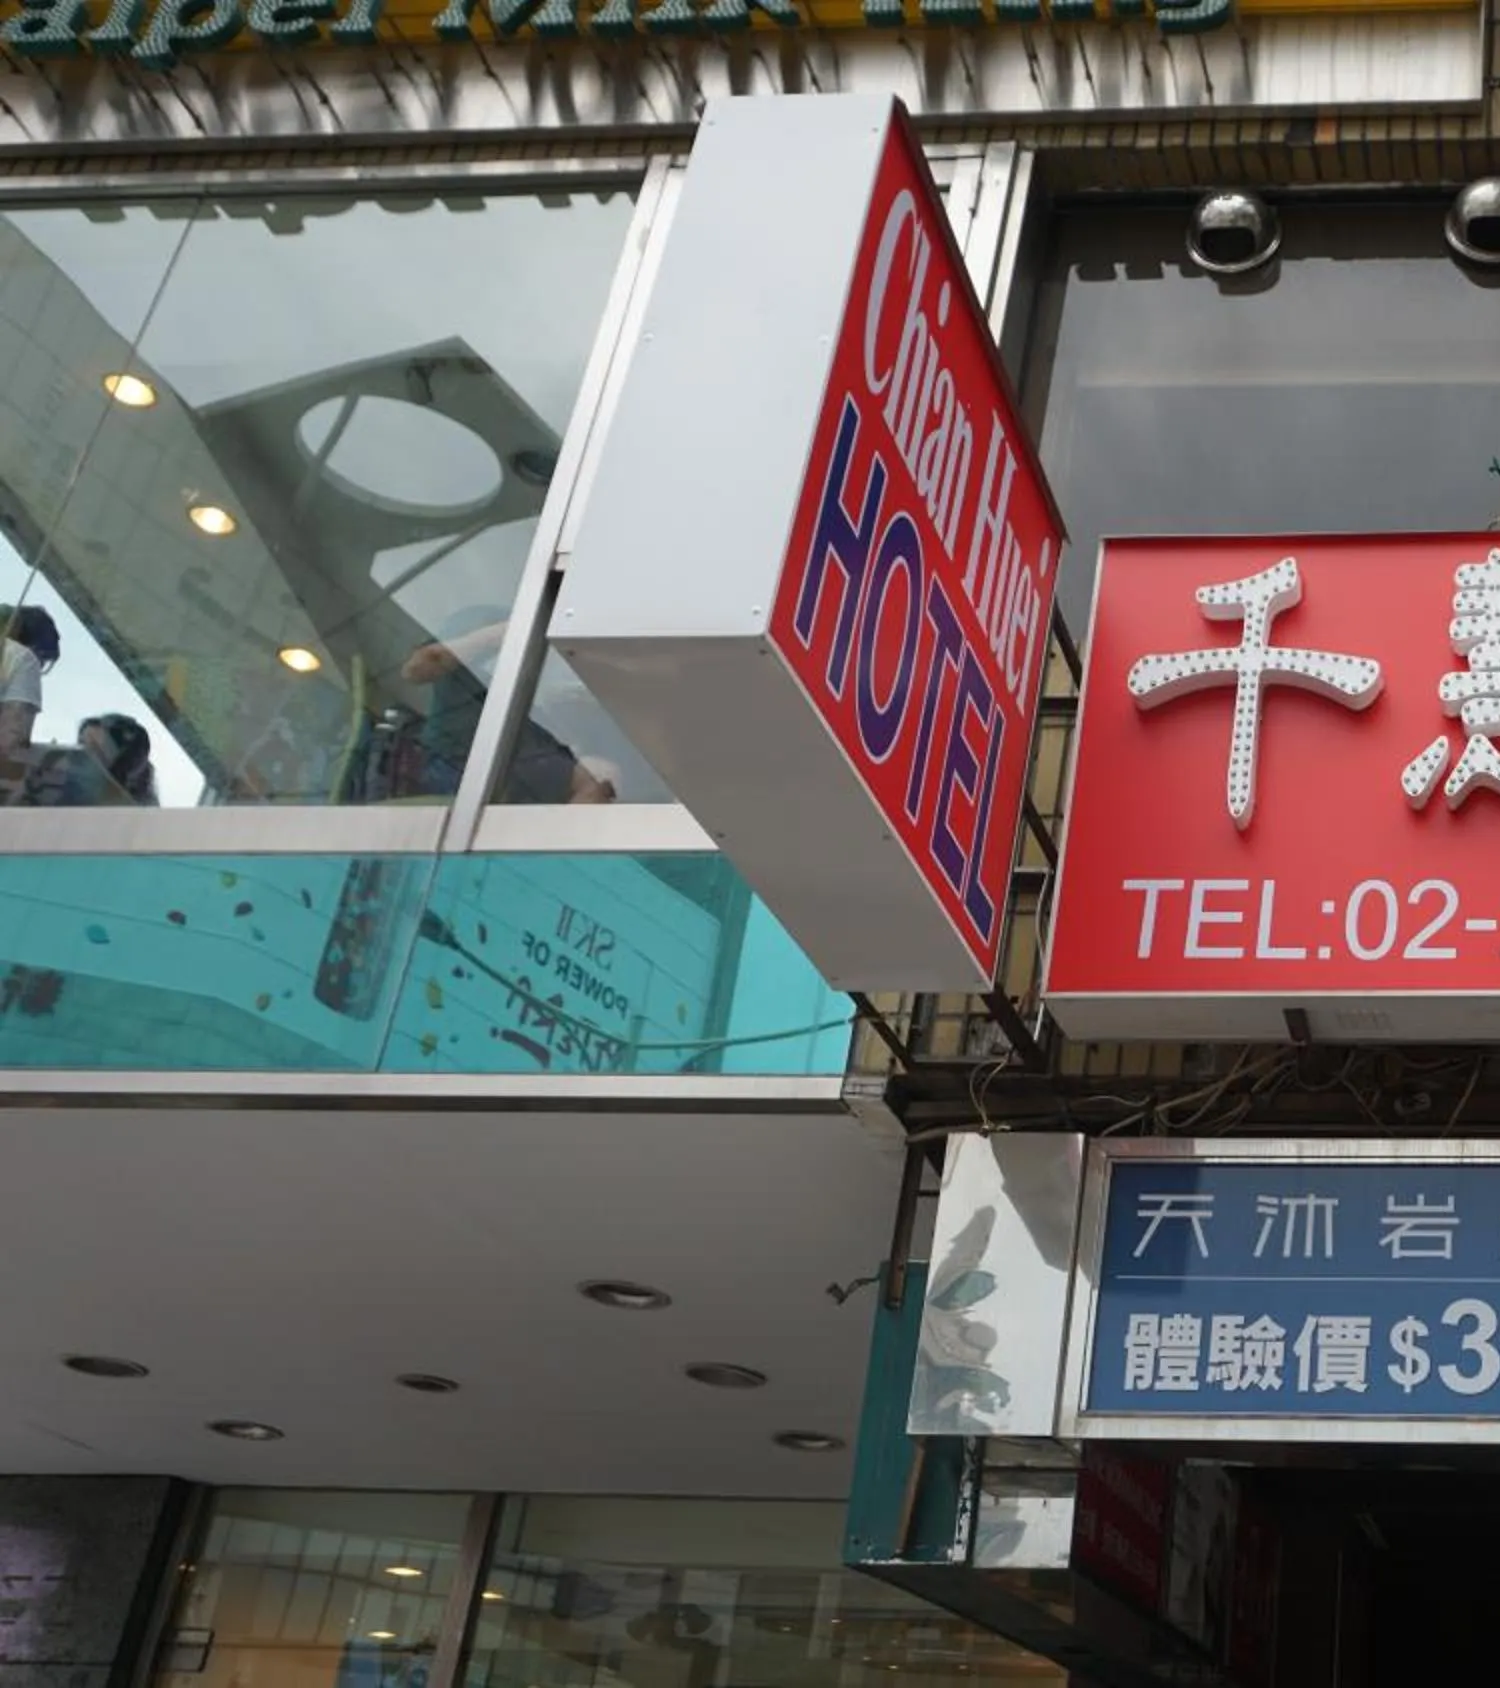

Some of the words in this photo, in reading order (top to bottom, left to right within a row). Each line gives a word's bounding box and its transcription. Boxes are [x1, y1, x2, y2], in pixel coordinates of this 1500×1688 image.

[794, 390, 1006, 949] HOTEL
[864, 188, 974, 561] Chian
[961, 407, 1050, 718] Huei
[1123, 1312, 1372, 1394] 體驗價
